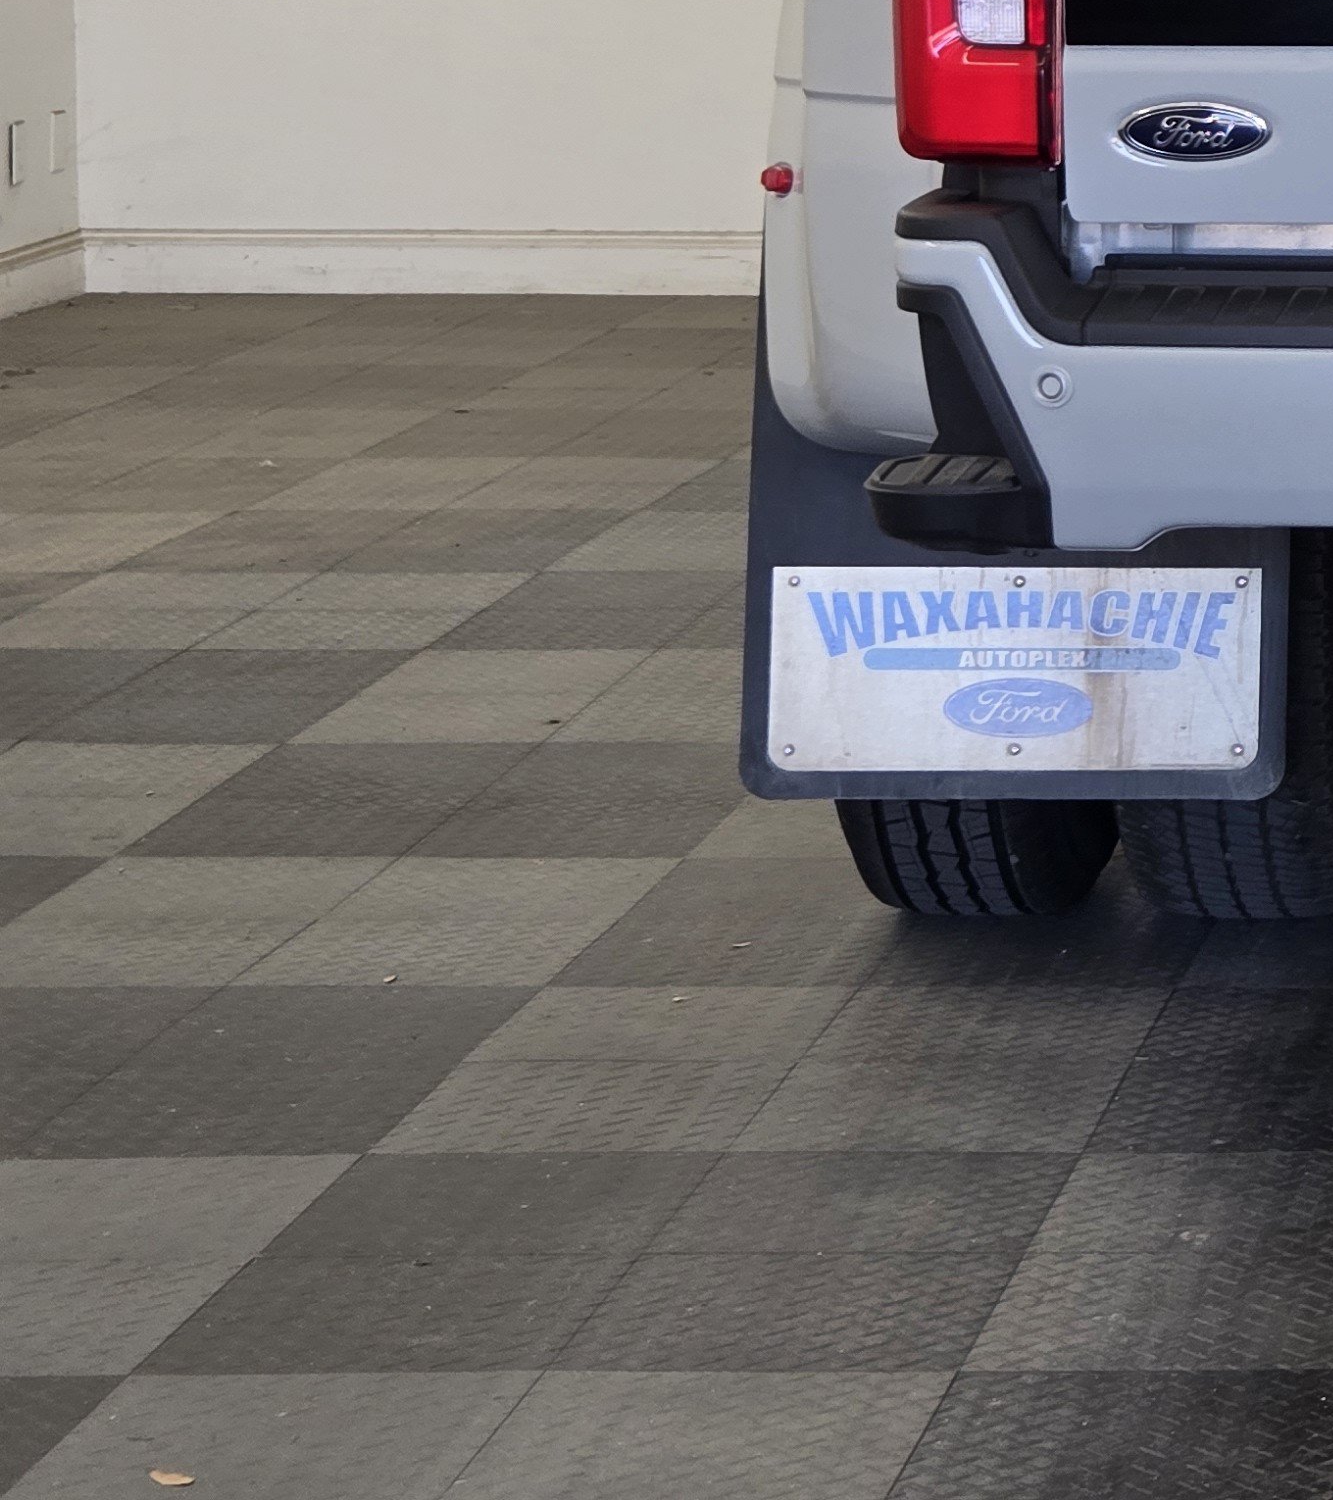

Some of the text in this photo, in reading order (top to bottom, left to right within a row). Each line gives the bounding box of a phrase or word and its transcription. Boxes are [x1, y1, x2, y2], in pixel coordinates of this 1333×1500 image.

[1154, 116, 1235, 148] Ford
[807, 589, 1237, 660] WAXAHACHIE
[958, 649, 1087, 668] AUTOPLEX
[969, 689, 1065, 725] Ford
